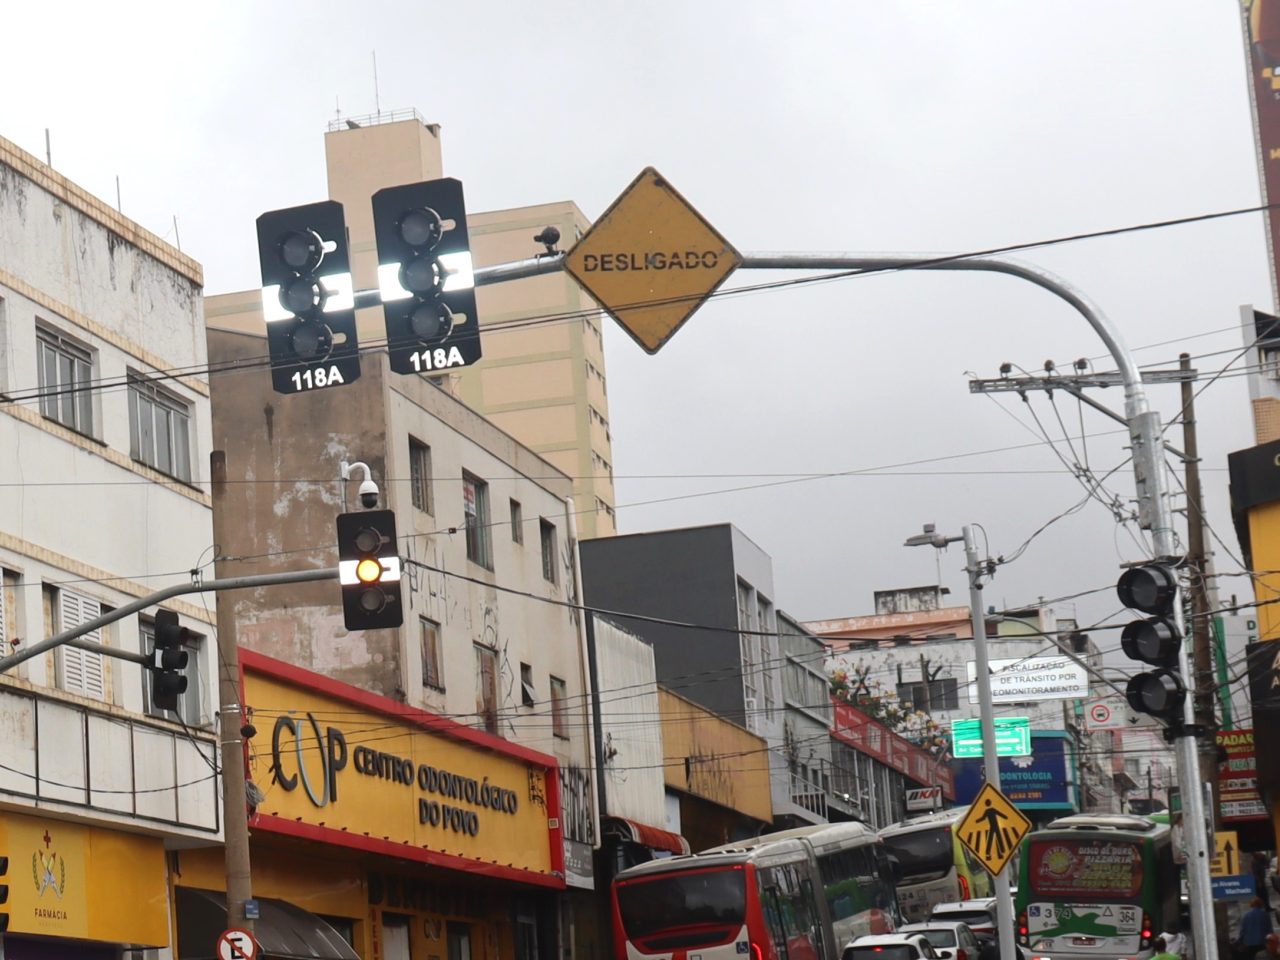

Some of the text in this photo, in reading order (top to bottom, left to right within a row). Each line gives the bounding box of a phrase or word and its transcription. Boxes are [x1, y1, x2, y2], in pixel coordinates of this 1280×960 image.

[584, 250, 718, 273] DESLIGADO
[409, 346, 465, 371] 118A
[291, 365, 344, 391] 118A
[1000, 677, 1011, 685] DE
[1058, 673, 1077, 681] POR
[992, 685, 1080, 697] EOMONITORAMENTO
[1216, 733, 1254, 745] PADAR
[353, 745, 414, 786] CENTRO
[418, 764, 518, 815] ODONTOLÓGICO
[1000, 772, 1052, 781] DONTOLOGIA
[418, 797, 479, 838] DO POVO
